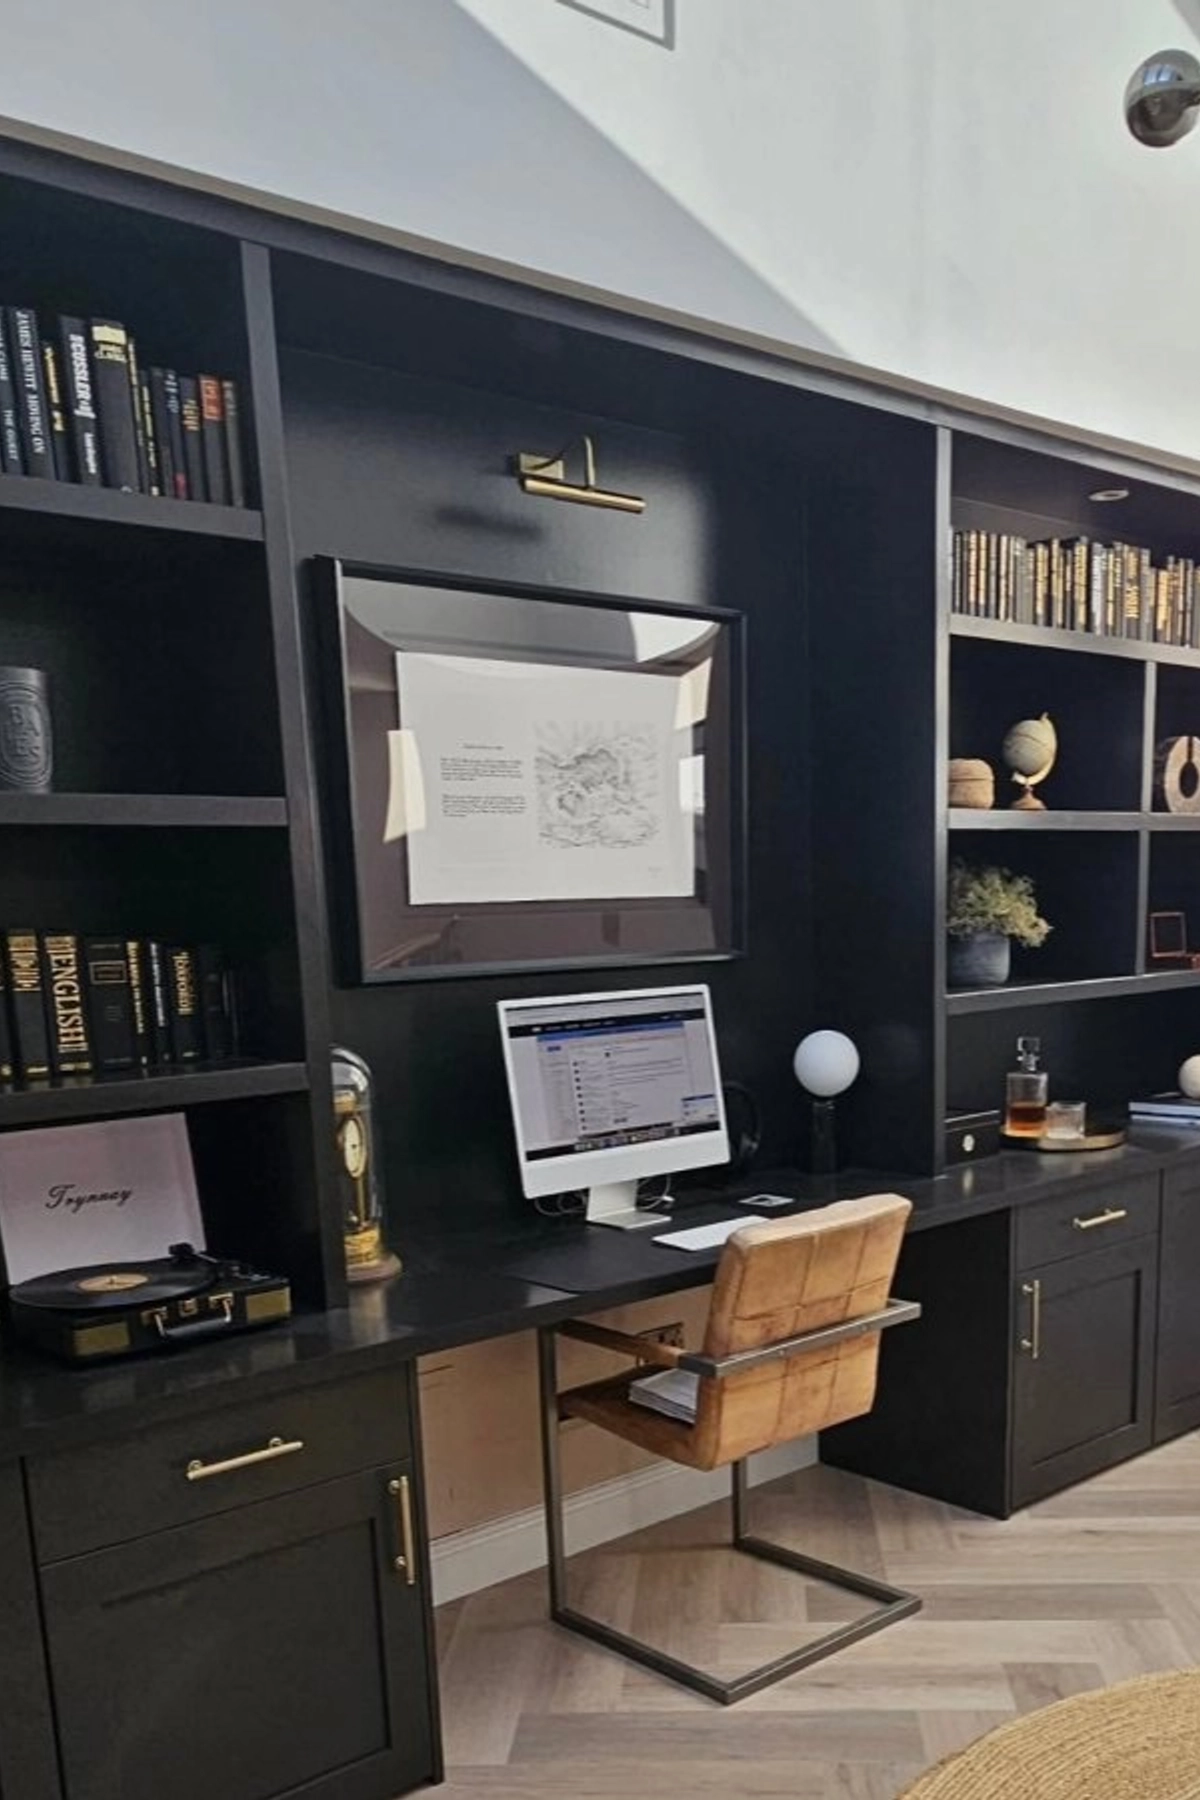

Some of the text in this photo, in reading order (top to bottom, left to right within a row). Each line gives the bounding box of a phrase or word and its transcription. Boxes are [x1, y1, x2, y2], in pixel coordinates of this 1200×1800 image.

[15, 311, 33, 347] JAMES
[70, 342, 92, 399] CUSSLER
[26, 394, 42, 434] MOVING
[32, 437, 46, 454] ON
[50, 953, 86, 1045] ENGLISH
